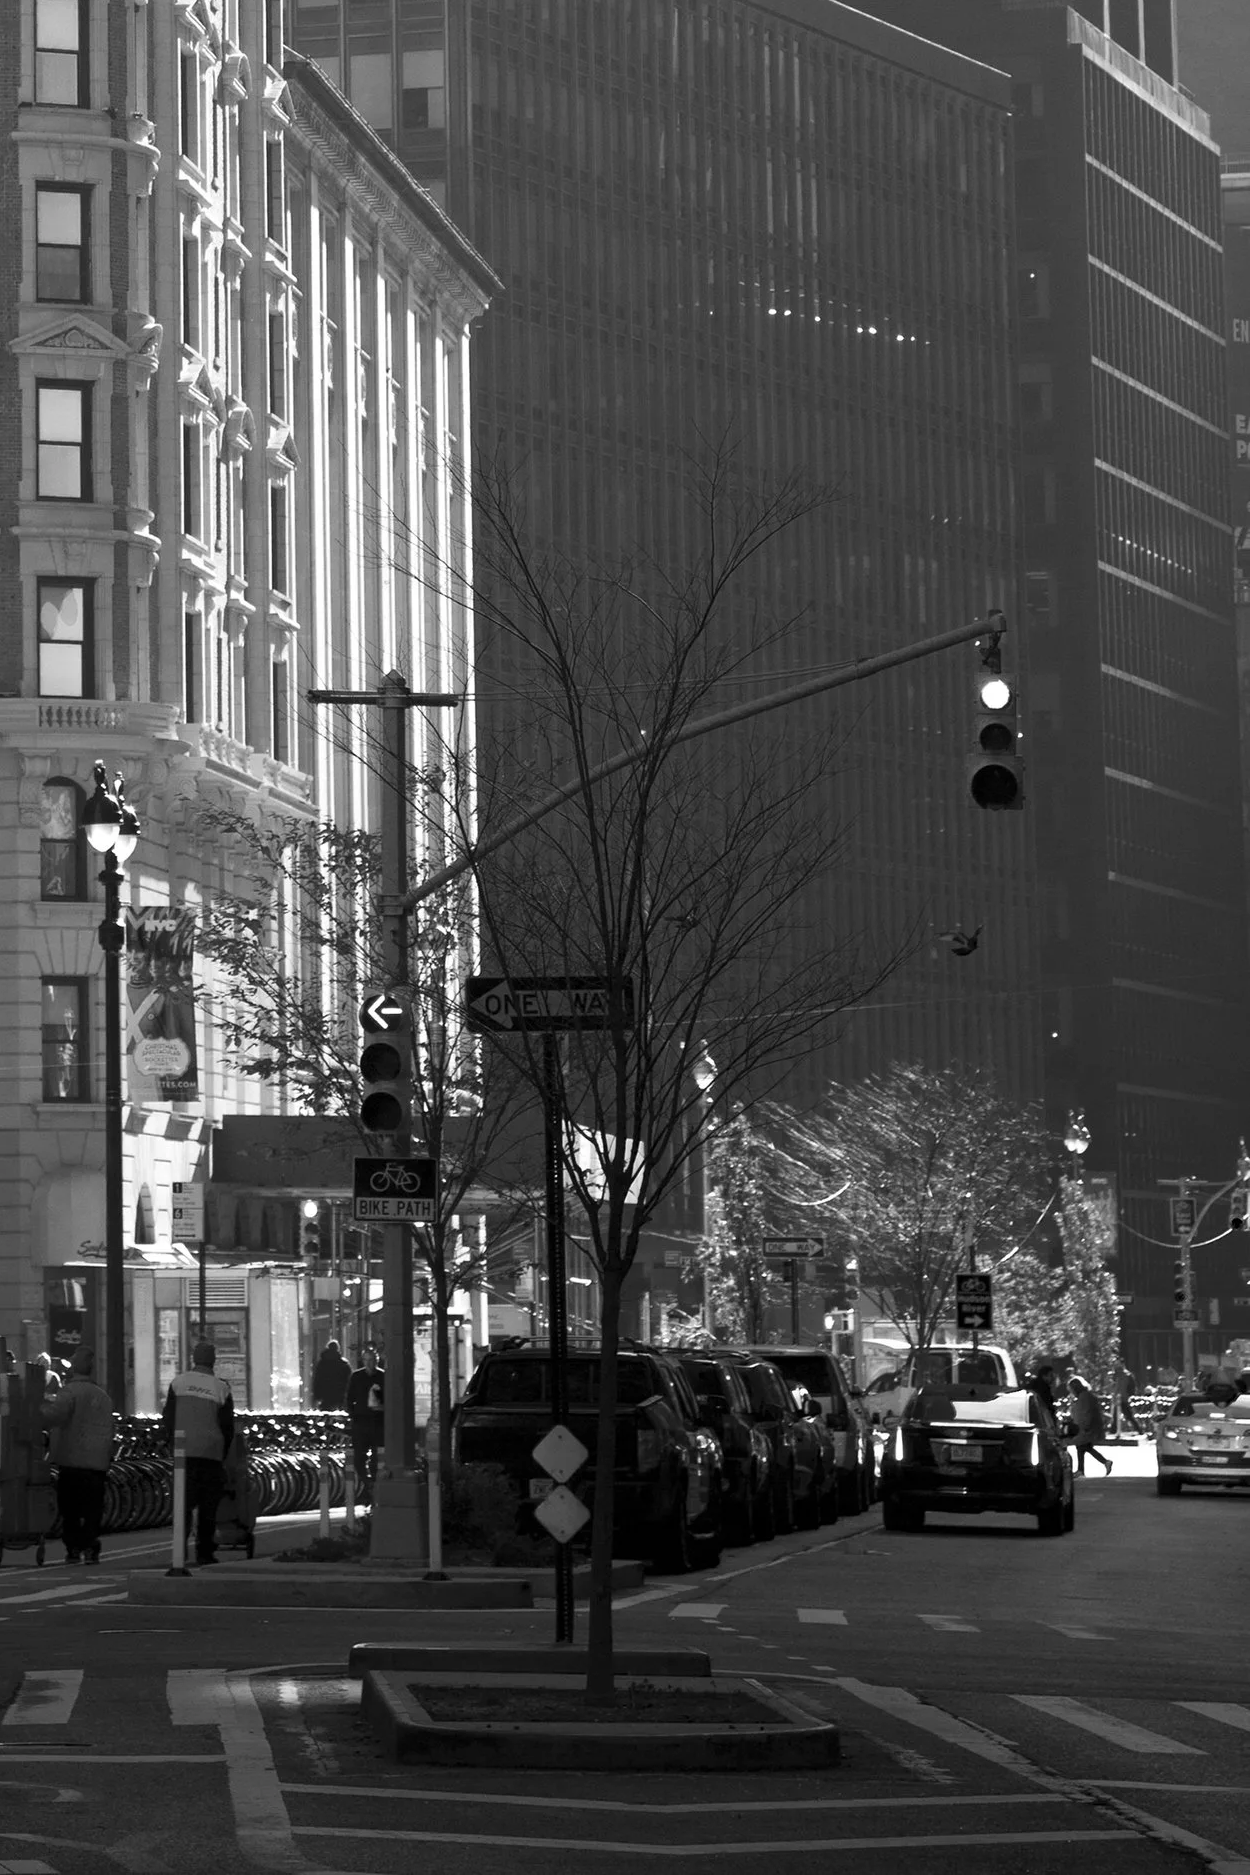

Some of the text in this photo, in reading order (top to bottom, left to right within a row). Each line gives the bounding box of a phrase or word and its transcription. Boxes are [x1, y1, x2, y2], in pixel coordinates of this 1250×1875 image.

[145, 919, 177, 931] NYC
[486, 994, 538, 1016] ONE
[174, 1209, 181, 1219] 6
[360, 1200, 431, 1216] BIKE PATH
[187, 1385, 214, 1396] DHL
